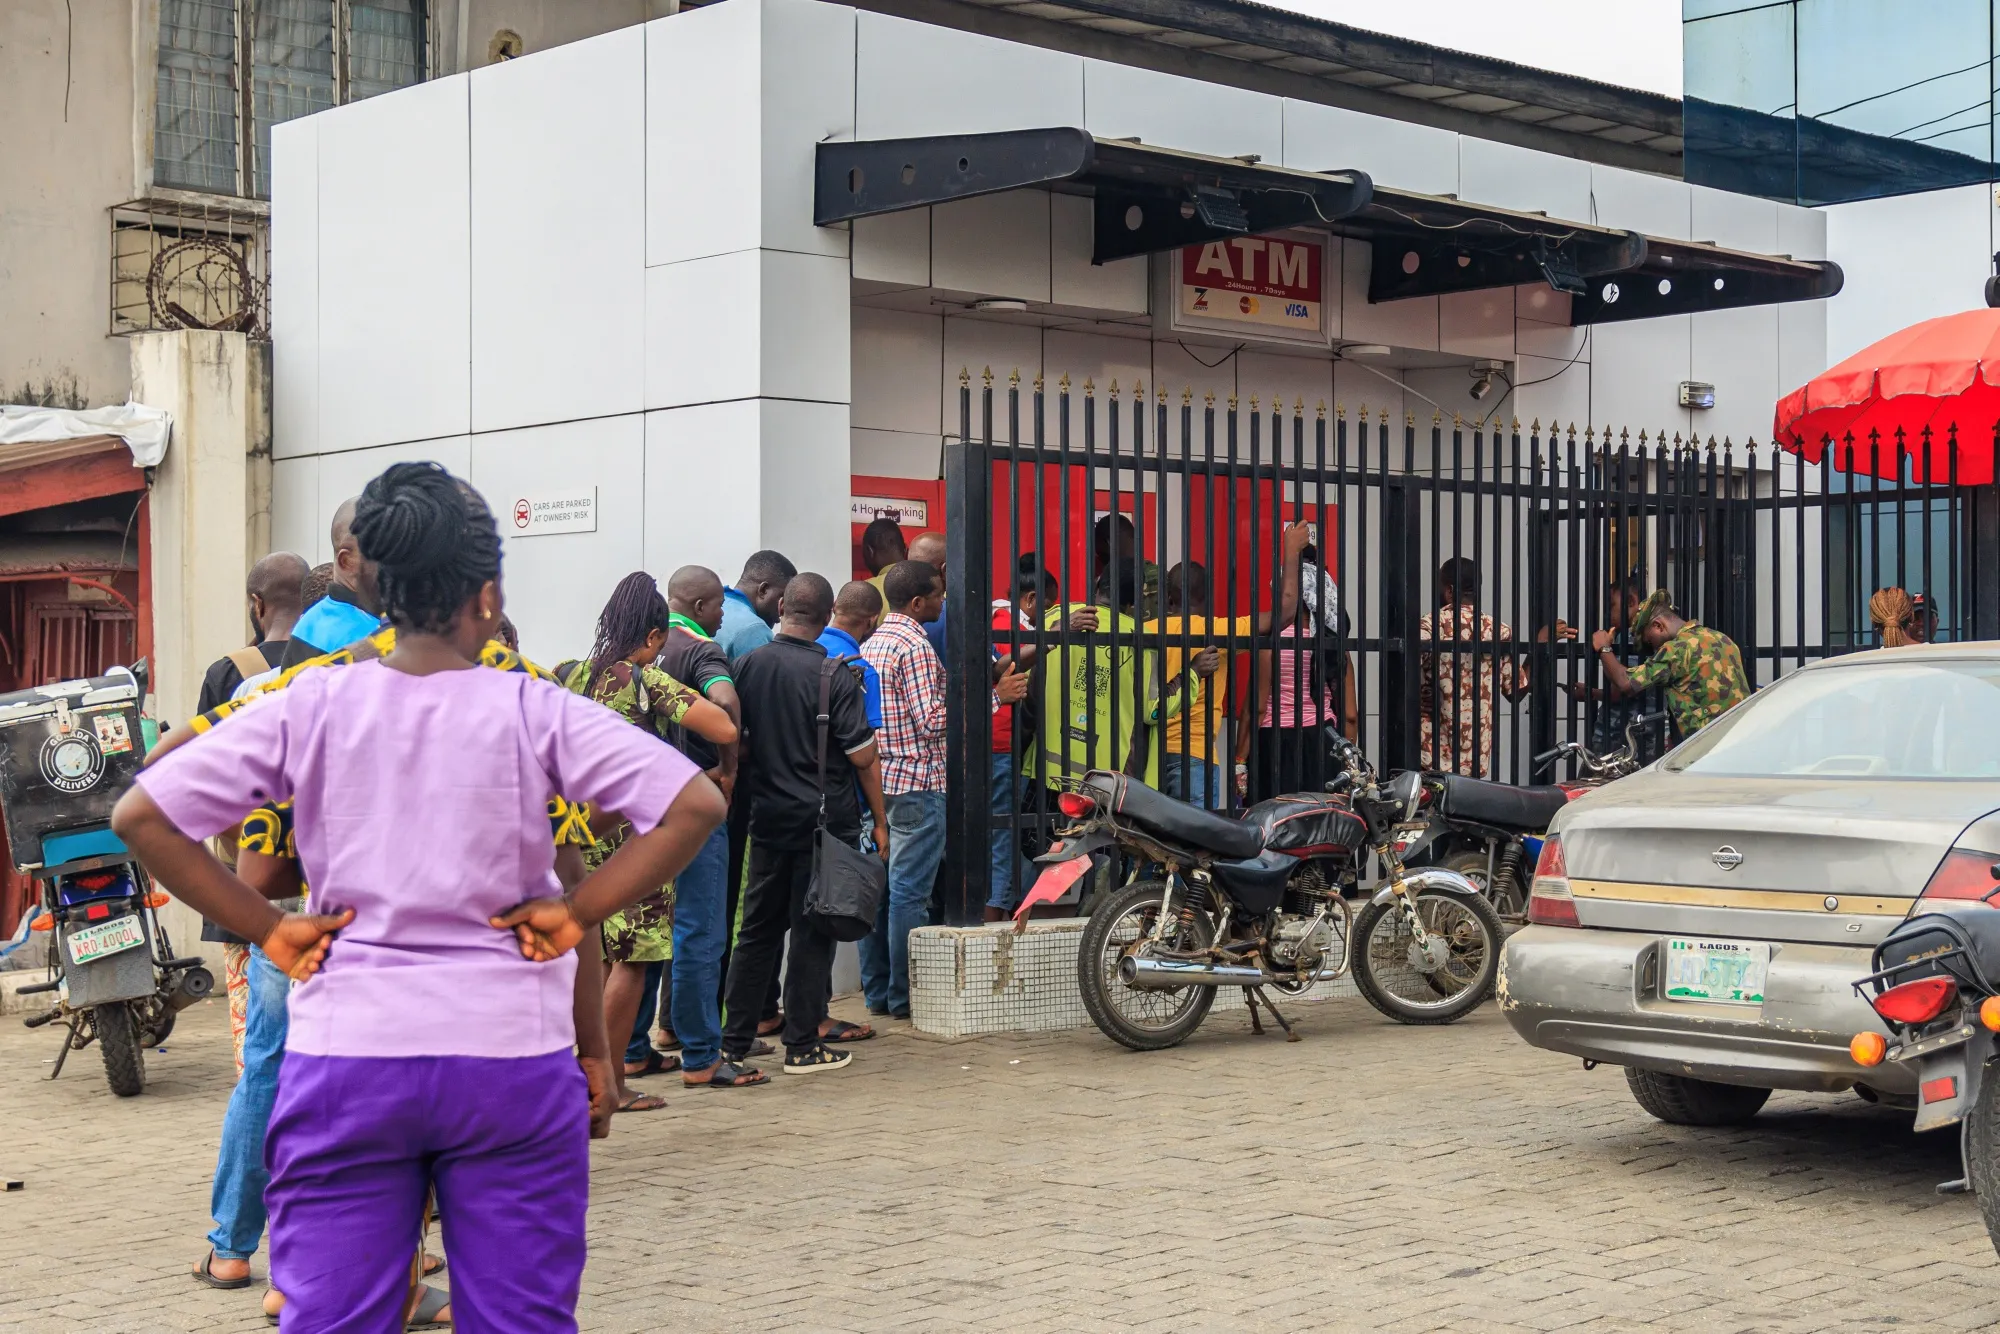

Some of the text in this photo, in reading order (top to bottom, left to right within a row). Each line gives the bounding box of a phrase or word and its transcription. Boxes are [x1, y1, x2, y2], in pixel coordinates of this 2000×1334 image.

[1195, 237, 1308, 289] ATM
[1284, 303, 1309, 318] VISA
[533, 498, 592, 511] CARS ARE PARKED
[534, 510, 589, 523] AT OWNERS' RISK
[53, 772, 98, 790] DELIVERS
[90, 921, 125, 935] LAGOS
[1845, 923, 1862, 932] G
[1699, 943, 1738, 951] LAGOS
